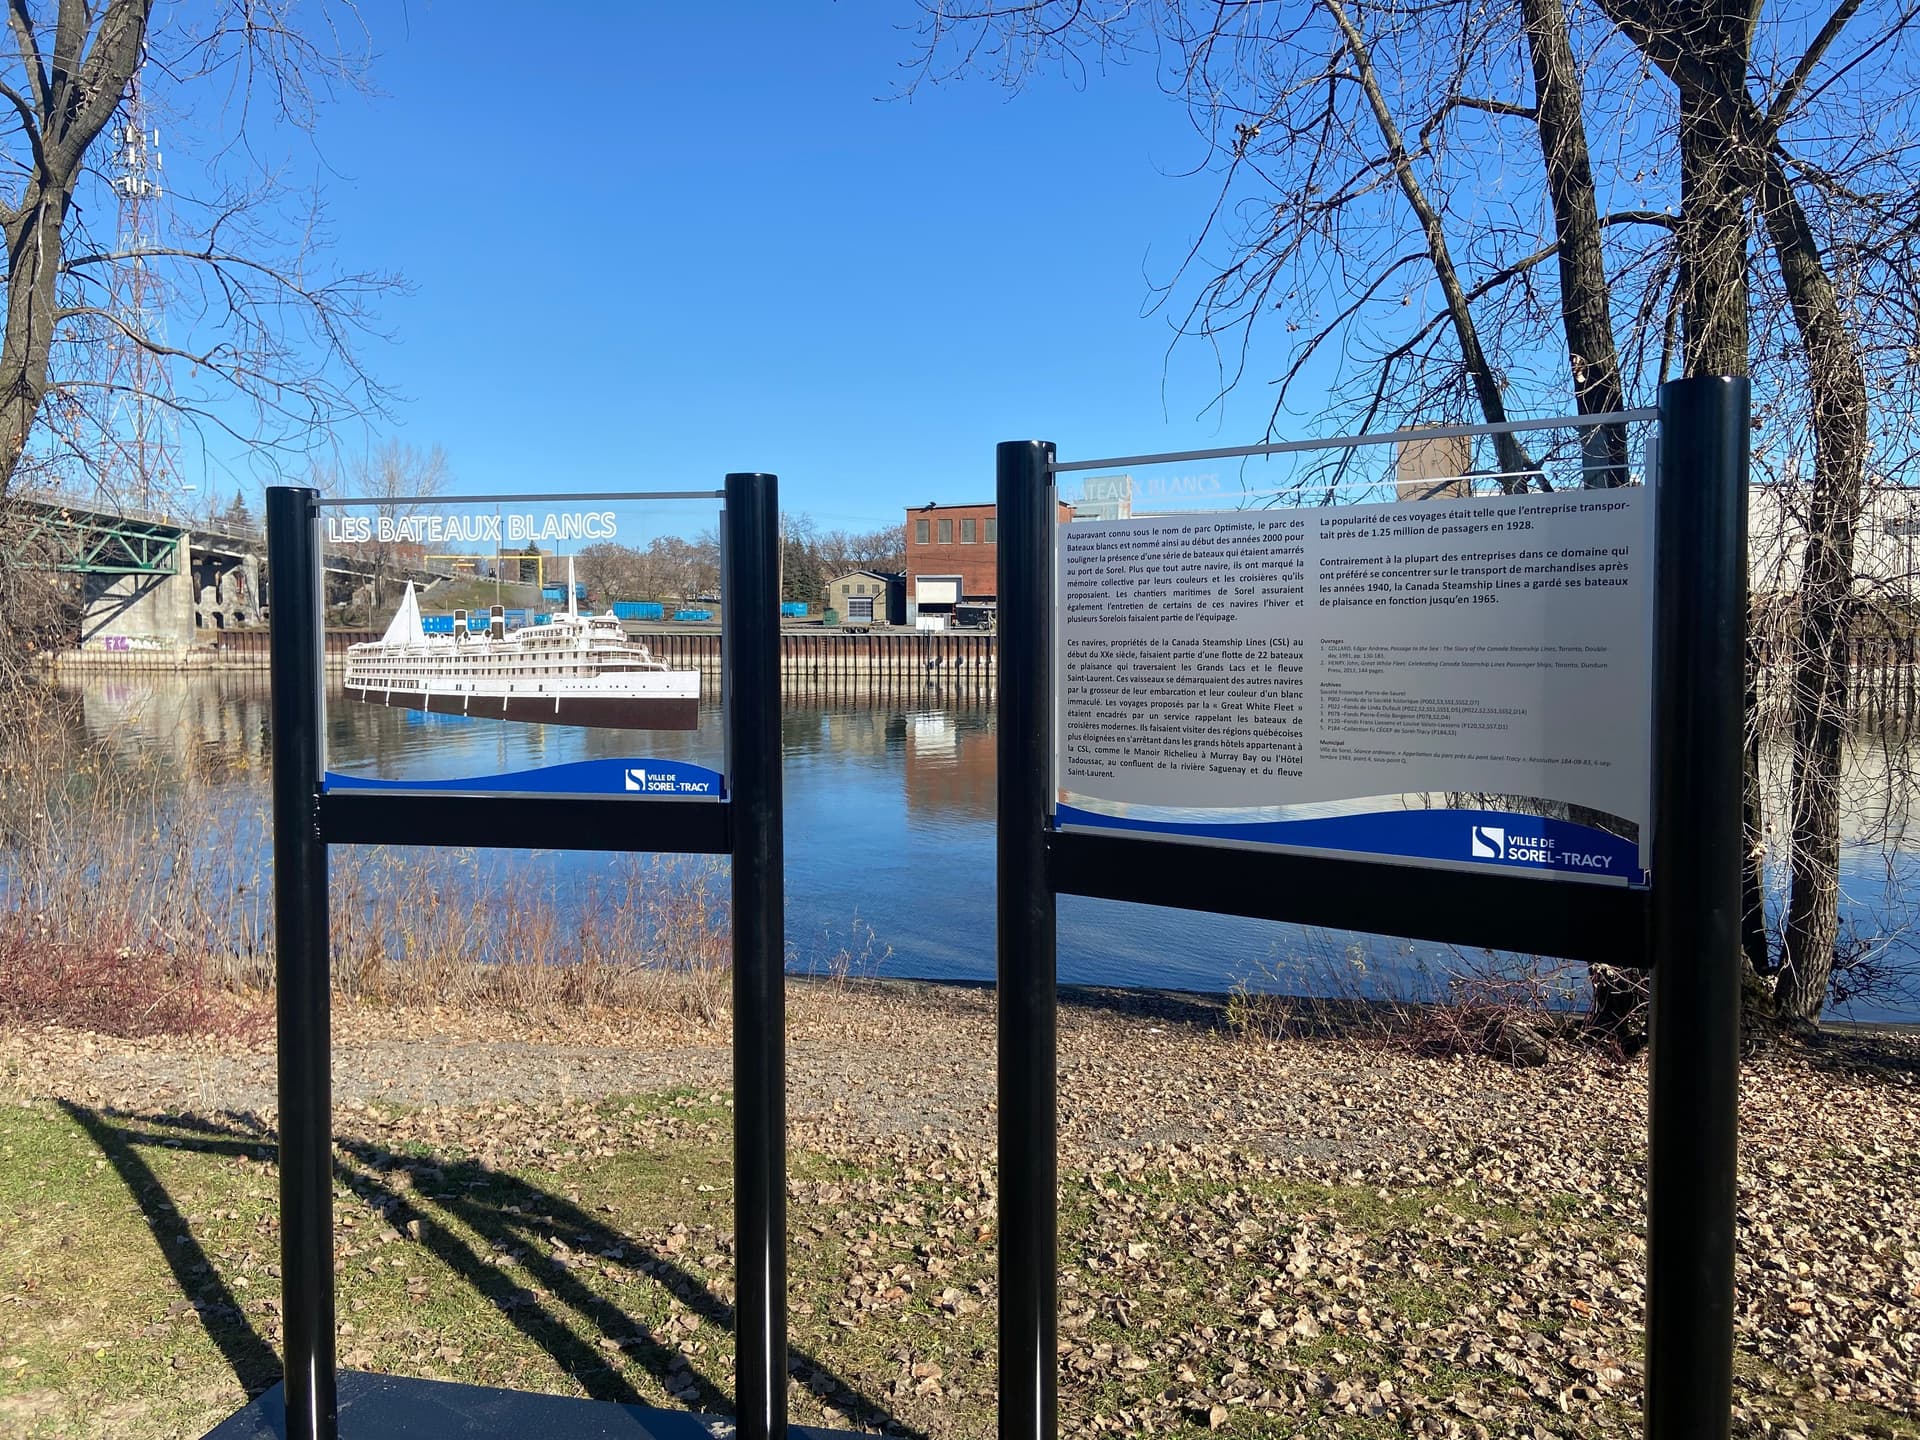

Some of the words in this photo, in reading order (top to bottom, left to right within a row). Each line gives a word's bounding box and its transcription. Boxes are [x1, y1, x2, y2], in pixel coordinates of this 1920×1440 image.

[1332, 514, 1378, 527] popularité
[1379, 514, 1391, 523] de
[1409, 513, 1447, 523] voyages
[1448, 509, 1472, 519] était
[1473, 508, 1495, 518] telle
[1497, 509, 1516, 518] que
[329, 516, 371, 543] LES
[378, 515, 500, 542] BATEAUX
[508, 512, 617, 541] BLANCS
[1067, 531, 1107, 541] Auparavant
[1182, 525, 1192, 534] de
[1194, 526, 1211, 535] parc
[1258, 521, 1266, 529] le
[1269, 522, 1287, 531] parc
[1320, 531, 1335, 539] tait
[1337, 530, 1356, 540] près
[1358, 529, 1369, 538] de
[1372, 528, 1391, 537] 1.25
[1393, 527, 1425, 536] million
[1428, 525, 1439, 534] de
[1442, 525, 1489, 535] passagers
[1132, 538, 1160, 549] nommé
[1161, 538, 1179, 547] ainsi
[1192, 537, 1215, 546] début
[1232, 535, 1261, 544] années
[1262, 534, 1283, 542] 2000
[1284, 535, 1304, 543] pour
[1067, 556, 1099, 565] souligner
[1107, 554, 1139, 564] présence
[1162, 552, 1181, 560] série
[1226, 549, 1239, 558] qui
[1240, 548, 1269, 556] étaient
[1270, 545, 1304, 555] amarrés
[1320, 557, 1384, 566] Contrairement
[1386, 556, 1392, 564] à
[1394, 555, 1402, 563] la
[1404, 554, 1439, 565] plupart
[1442, 553, 1458, 562] des
[1461, 552, 1516, 562] entreprises
[1519, 550, 1544, 559] dans
[1561, 548, 1608, 557] domaine
[1612, 546, 1628, 557] qui
[1078, 568, 1093, 576] port
[1233, 561, 1242, 569] ils
[1262, 559, 1293, 570] marqué
[1296, 559, 1304, 567] la
[1336, 570, 1368, 581] préféré
[1382, 569, 1432, 578] concentrer
[1450, 567, 1459, 576] le
[1461, 566, 1507, 576] transport
[1509, 565, 1522, 574] de
[1524, 563, 1596, 573] marchandises
[1598, 561, 1628, 573] après
[1067, 579, 1098, 588] mémoire
[1101, 578, 1135, 586] collective
[1176, 576, 1208, 584] couleurs
[1239, 573, 1278, 582] croisières
[1334, 584, 1366, 592] années
[1394, 583, 1403, 591] la
[1405, 581, 1440, 591] Canada
[1442, 580, 1493, 591] Steamship
[1496, 580, 1521, 588] Lines
[1533, 578, 1562, 589] gardé
[1585, 577, 1628, 586] bateaux
[1133, 589, 1167, 598] chantiers
[1173, 588, 1212, 597] maritimes
[1218, 587, 1228, 596] de
[1234, 586, 1255, 595] Sorel
[1262, 586, 1304, 594] assuraient
[1067, 603, 1103, 612] également
[1163, 601, 1192, 609] certains
[1332, 597, 1373, 608] plaisance
[1389, 596, 1427, 605] fonction
[1067, 615, 1098, 624] plusieurs
[1099, 614, 1127, 622] Sorelois
[1161, 614, 1183, 623] partie
[648, 782, 709, 791] SOREL-TRACY
[1508, 836, 1537, 847] VILLE
[1540, 838, 1555, 848] DE
[1508, 848, 1612, 868] SOREL-TRACY
